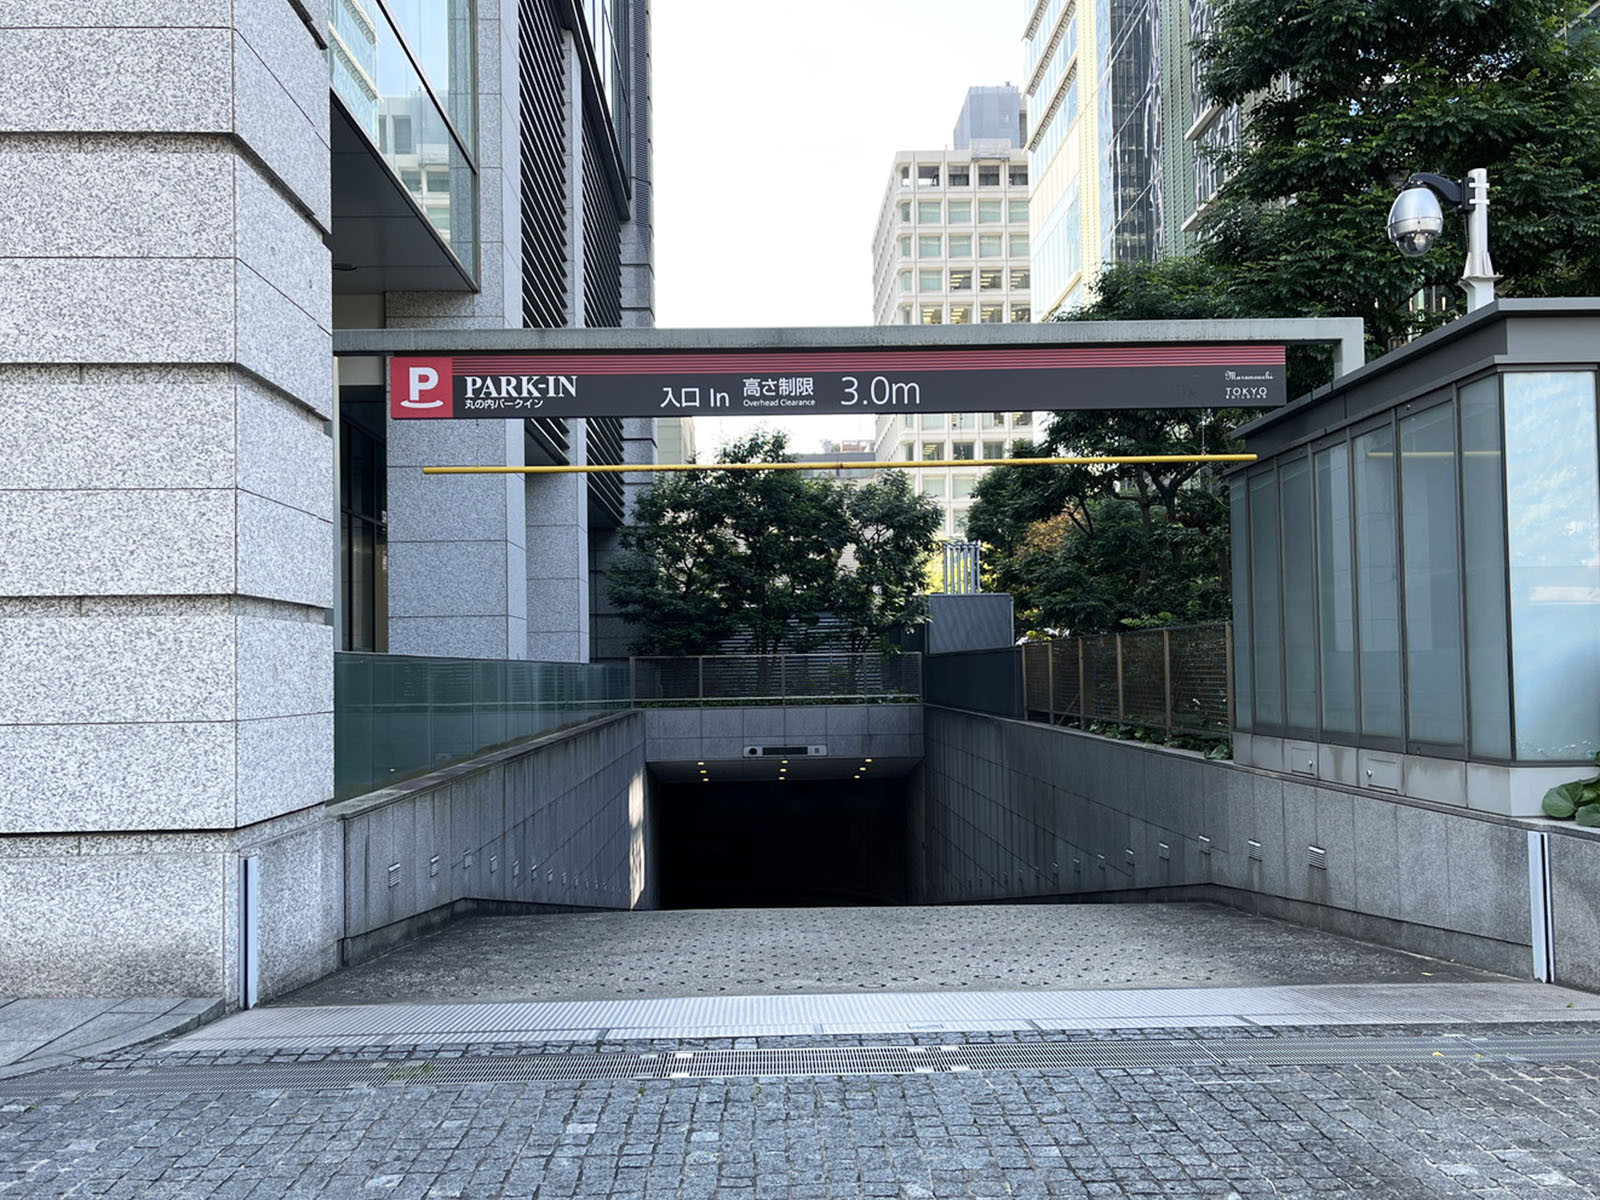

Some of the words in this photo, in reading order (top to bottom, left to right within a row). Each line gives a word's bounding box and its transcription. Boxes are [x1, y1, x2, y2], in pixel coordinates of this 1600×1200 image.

[409, 367, 439, 400] P
[464, 376, 577, 398] PARK-IN
[742, 377, 814, 397] 高さ制限
[840, 376, 921, 406] 3.0m
[1225, 387, 1268, 396] TOKYO
[464, 399, 544, 409] 丸の内パークイン
[660, 387, 700, 408] 入口
[710, 388, 730, 407] In
[743, 399, 779, 407] Overhead
[780, 399, 816, 407] Clearance
